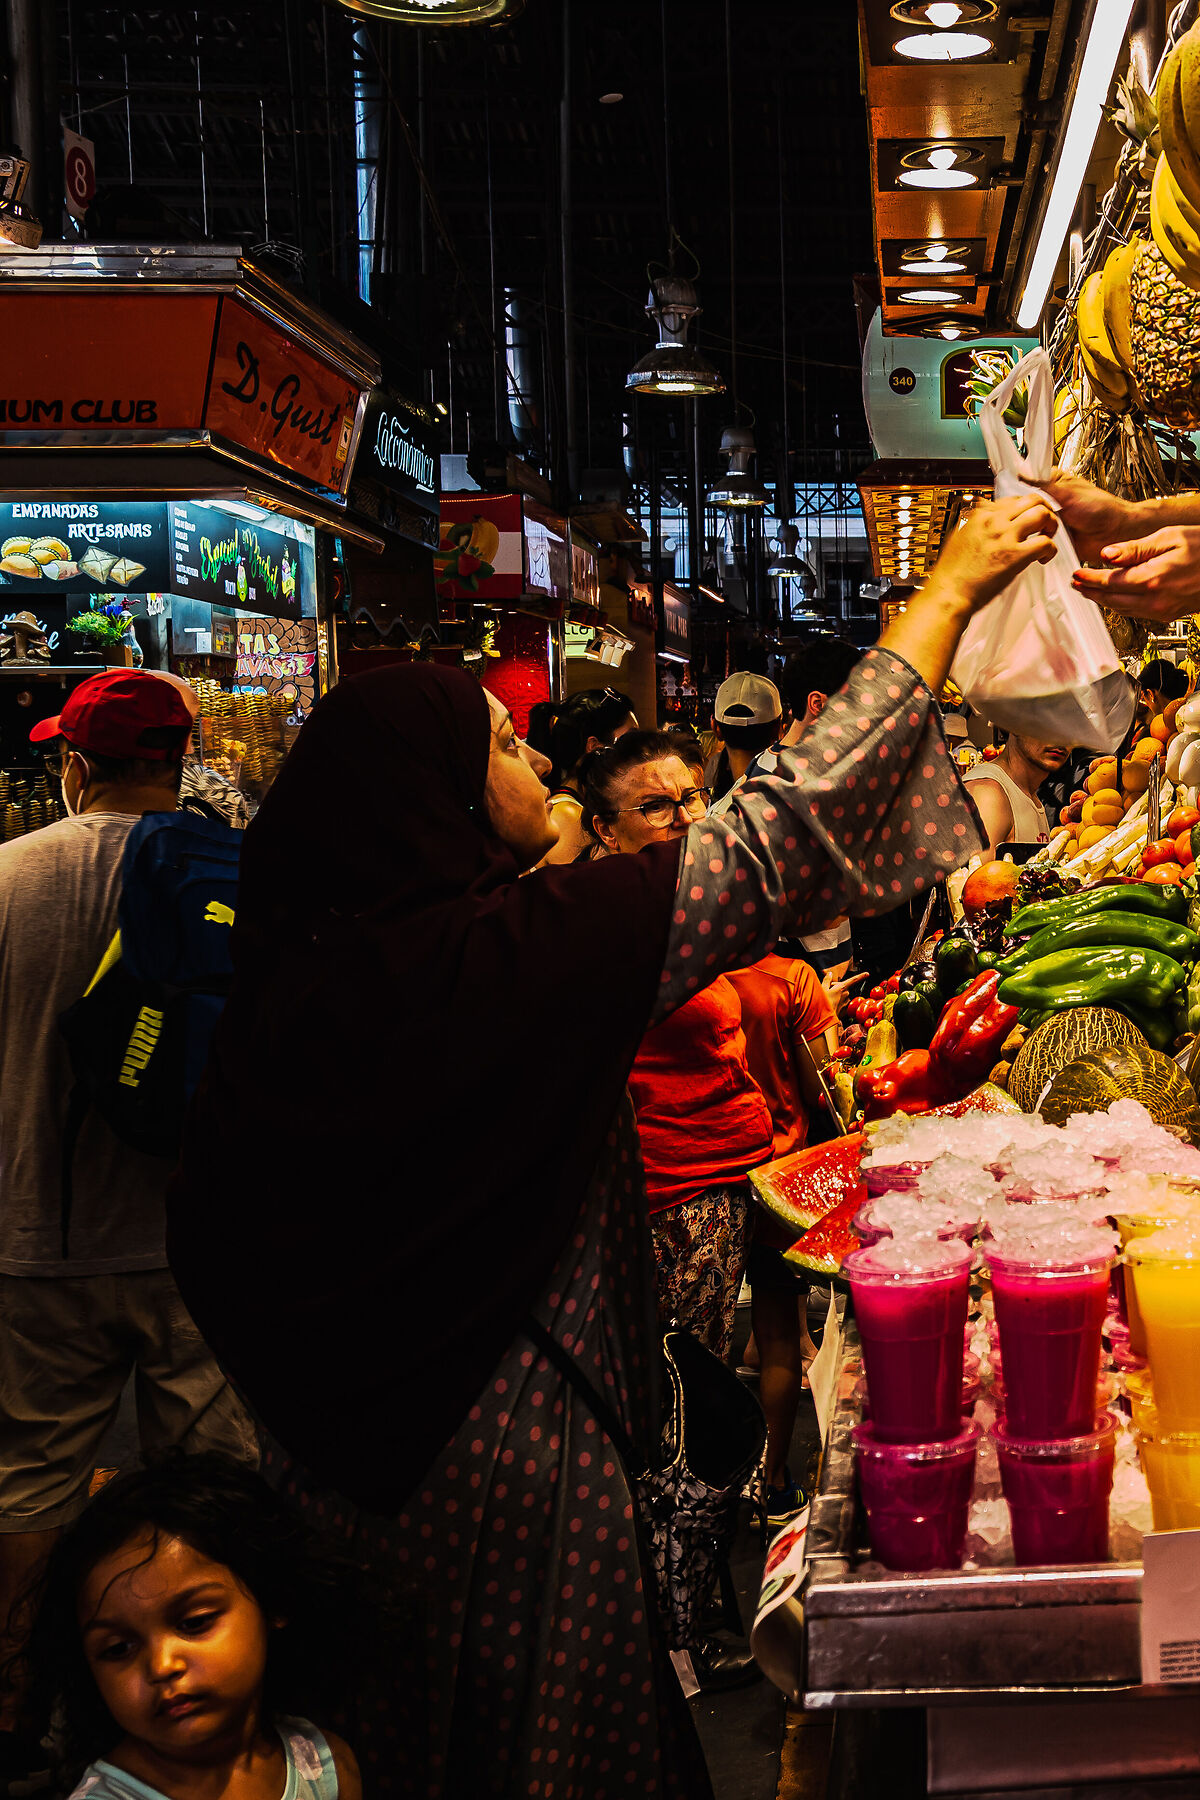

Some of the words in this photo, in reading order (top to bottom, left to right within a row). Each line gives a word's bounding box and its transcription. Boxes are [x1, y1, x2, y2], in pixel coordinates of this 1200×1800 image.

[74, 157, 87, 198] 8
[892, 376, 913, 387] 340
[72, 400, 157, 424] CLUB
[12, 503, 98, 518] EMPANADAS
[67, 523, 152, 543] ARTESANAS
[118, 1005, 165, 1087] PUMA
